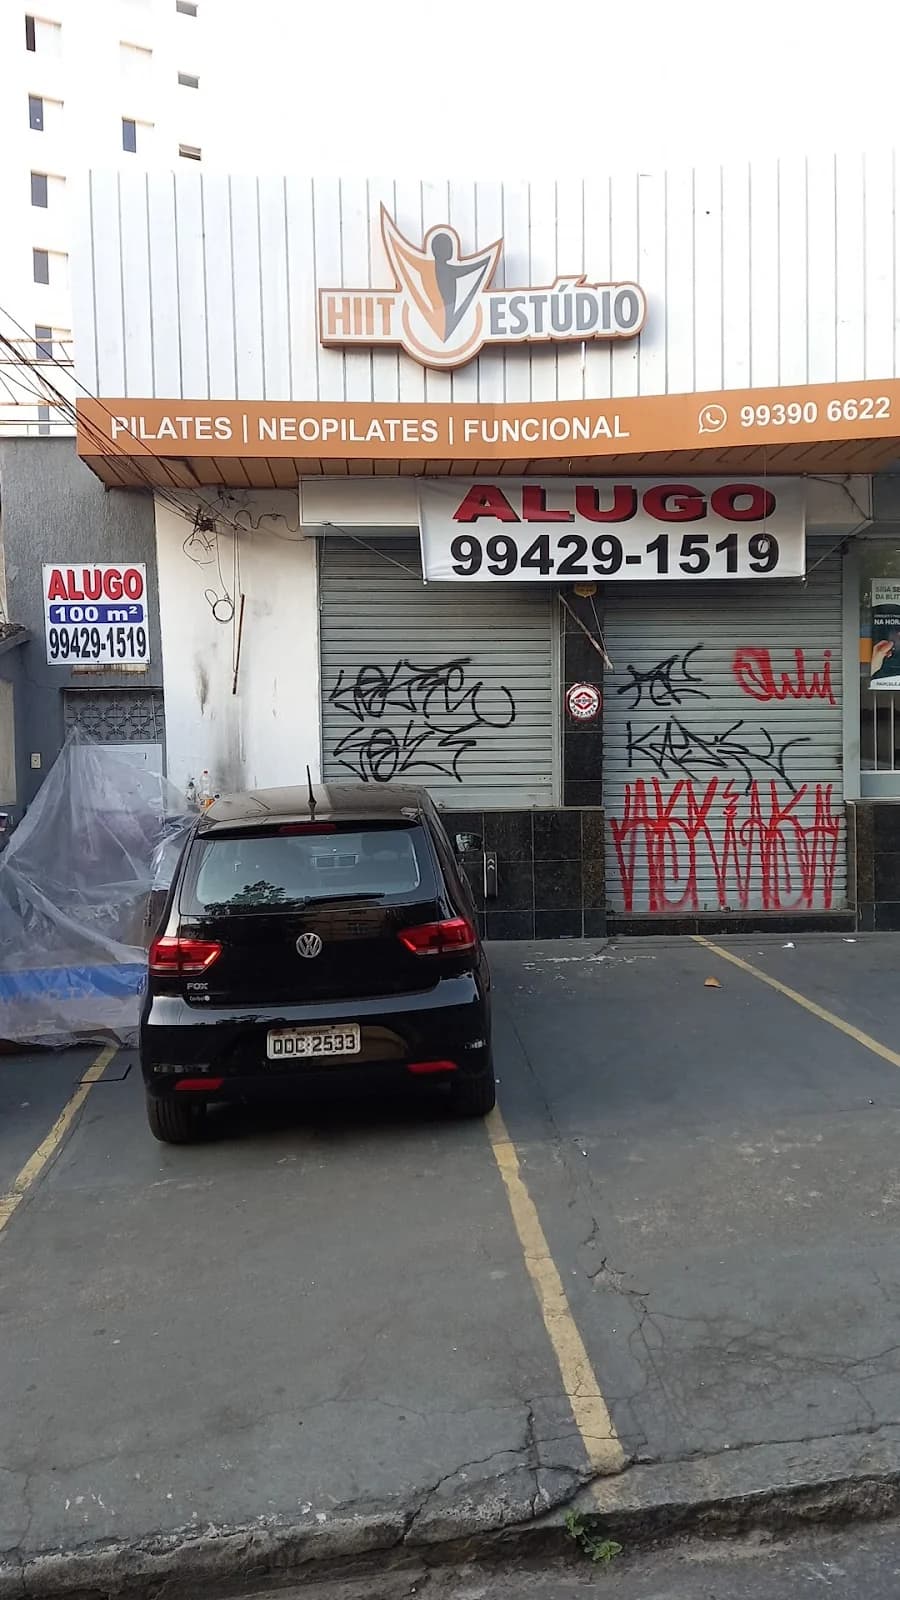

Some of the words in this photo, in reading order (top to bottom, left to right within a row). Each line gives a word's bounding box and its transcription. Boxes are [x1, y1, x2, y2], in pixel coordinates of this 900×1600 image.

[327, 296, 395, 335] HIIT
[489, 284, 640, 336] ESTÚDIO
[111, 415, 233, 441] PILATES
[258, 416, 439, 443] NEOPILATES
[463, 414, 630, 443] FUNCIONAL
[740, 402, 818, 427] 99390
[826, 397, 891, 422] 6622
[452, 483, 777, 523] ALUGO
[451, 532, 781, 577] 99429-1519
[47, 568, 144, 601] ALUGO
[55, 606, 99, 622] 100
[49, 626, 147, 659] 99429-1519
[186, 982, 209, 991] FOX
